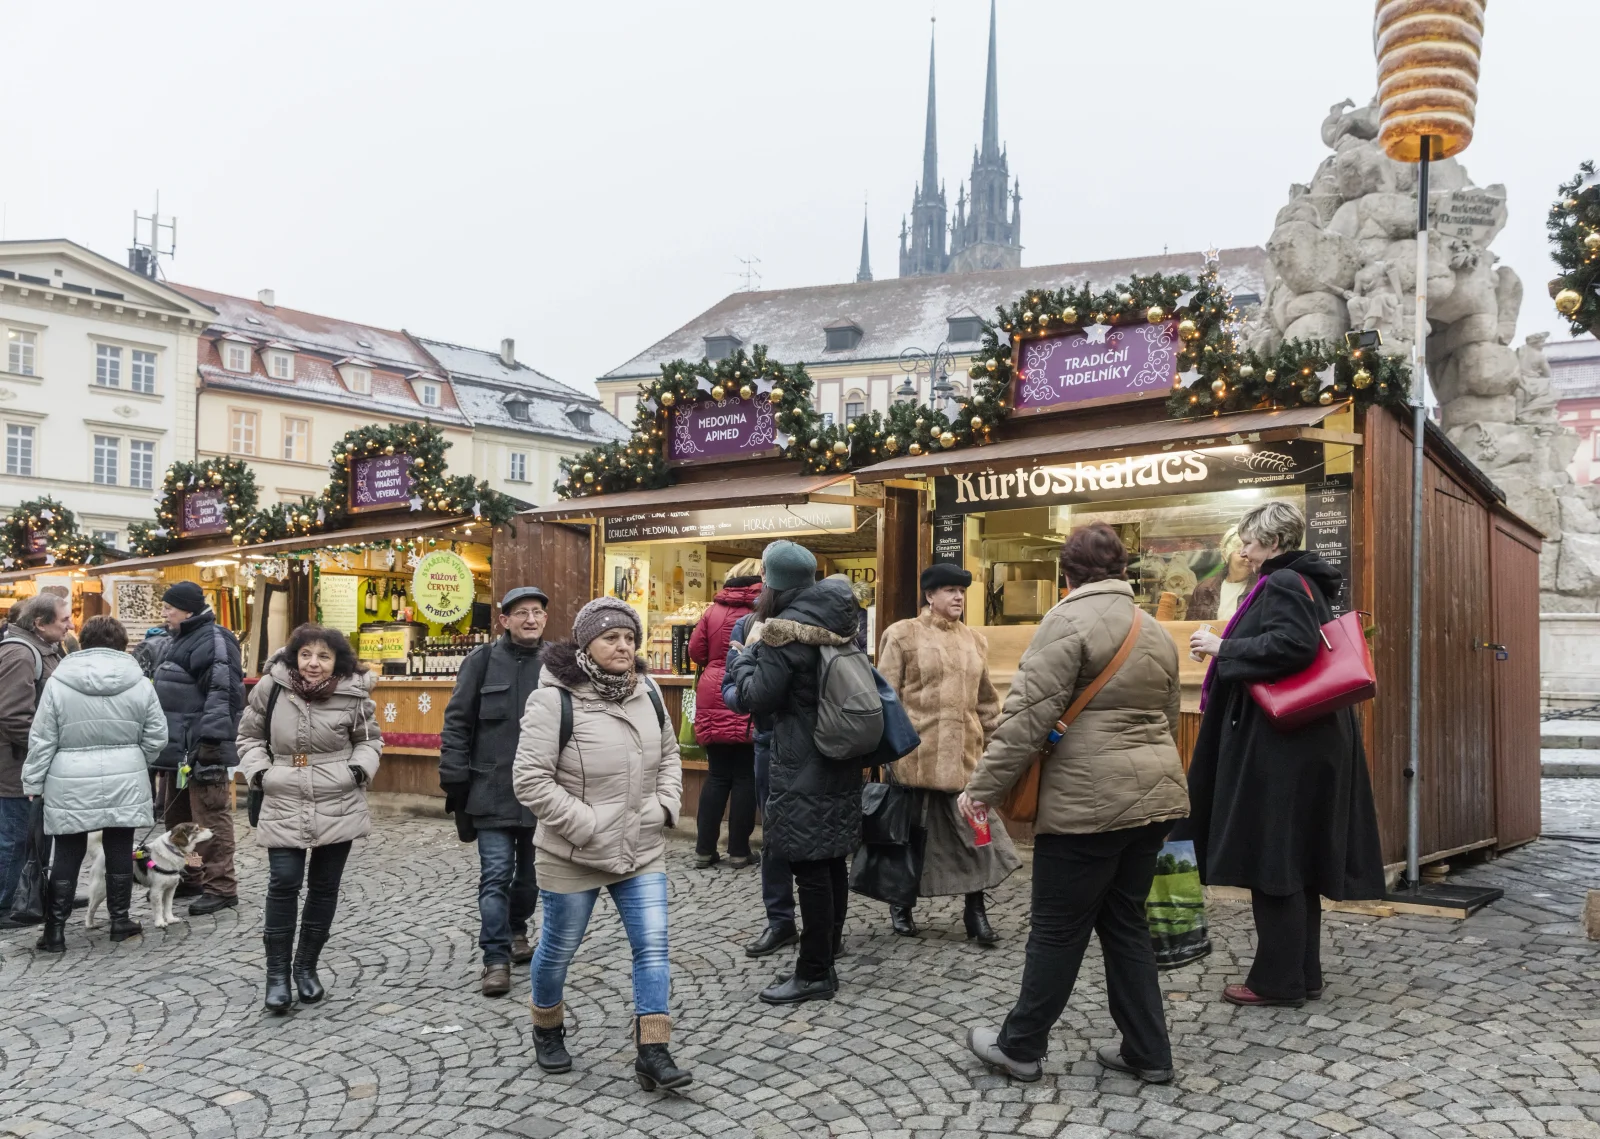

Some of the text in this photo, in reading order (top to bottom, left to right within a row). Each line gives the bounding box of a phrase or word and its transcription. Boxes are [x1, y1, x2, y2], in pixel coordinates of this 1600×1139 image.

[1065, 346, 1130, 371] TRADIČNÍ
[1059, 365, 1132, 388] TRDELNÍKY
[717, 399, 727, 408] 69
[698, 412, 747, 429] MEDOVINA
[705, 428, 739, 442] APIMED
[376, 466, 399, 479] RODINNÉ
[374, 476, 401, 488] VINAŘSTVÍ
[1238, 474, 1295, 484] www.precimat.eu
[375, 488, 400, 498] VEVERKA
[1315, 510, 1342, 518] Skořice
[743, 513, 832, 532] HORKÁ MEDOVINA
[1310, 519, 1347, 527] Cinnamon
[608, 525, 639, 539] OCHUCENÁ
[642, 525, 679, 535] MEDOVINA
[1318, 526, 1339, 535] Fahéj
[1315, 541, 1342, 549] Vanilka
[422, 556, 466, 580] SVAŘENÉ VÍNO
[430, 571, 457, 582] RŮŽOVÉ
[427, 581, 460, 592] ČERVENÉ
[425, 603, 461, 617] RYBÍZOVÉ
